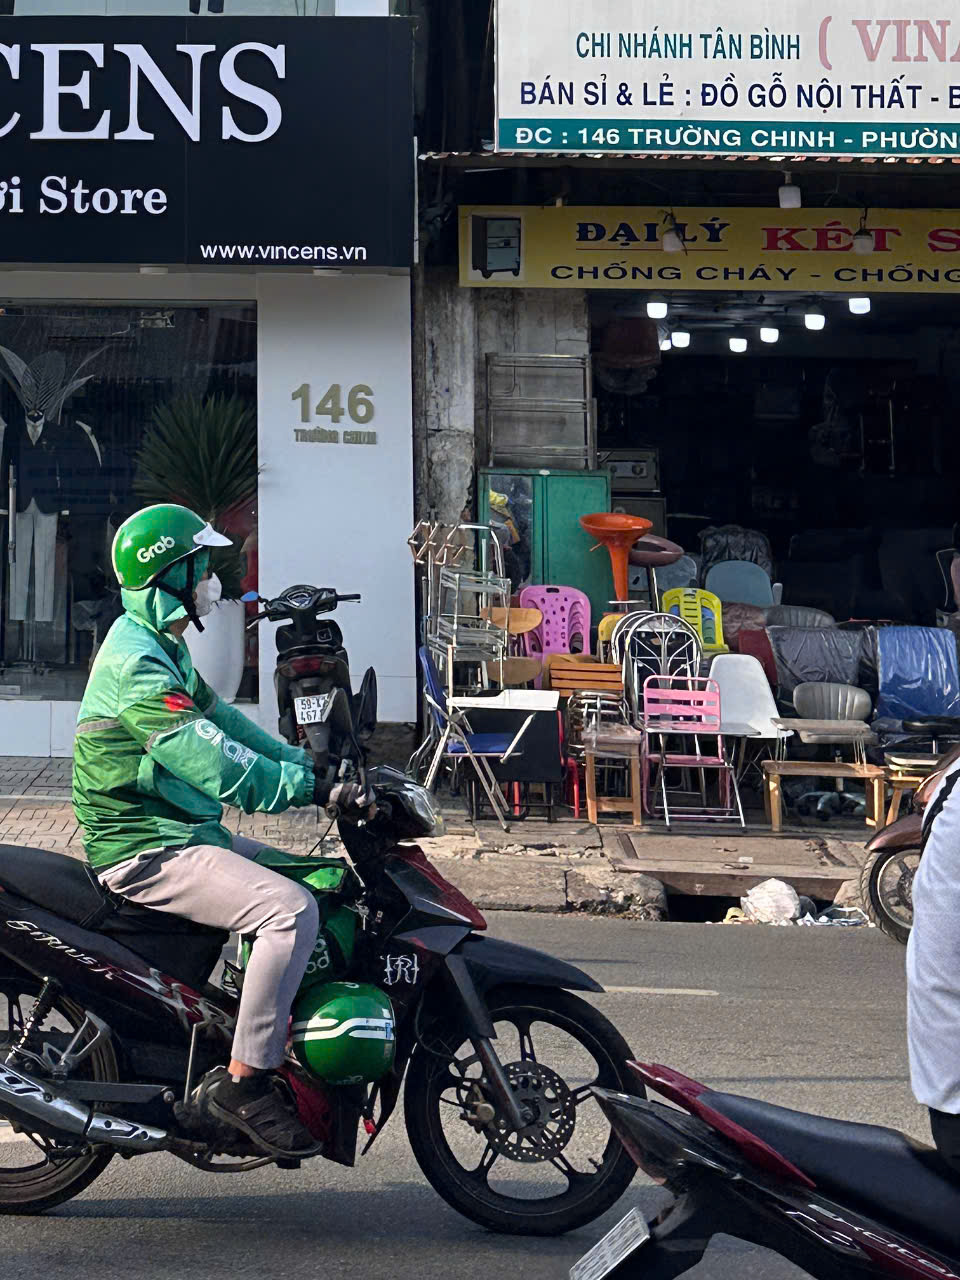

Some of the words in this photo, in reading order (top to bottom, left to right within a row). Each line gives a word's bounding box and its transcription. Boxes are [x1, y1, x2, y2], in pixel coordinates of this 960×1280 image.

[577, 32, 610, 58] CHI
[618, 26, 692, 59] NHÁNH
[700, 27, 742, 59] TÂN
[750, 28, 800, 60] BÌNH
[852, 20, 960, 62] VIN
[521, 75, 573, 105] BÁN
[584, 74, 607, 106] SỈ
[616, 83, 633, 106] &
[643, 73, 674, 106] LẺ
[701, 73, 738, 108] ĐỒ
[748, 72, 787, 108] GỖ
[797, 77, 841, 114] NỘI
[851, 75, 922, 109] THẤT
[515, 127, 552, 145] ĐC
[577, 127, 620, 145] 146
[628, 124, 741, 147] TRƯỜNG
[751, 129, 835, 147] CHINH
[862, 128, 960, 149] PHƯỜN
[40, 176, 168, 214] Store
[576, 222, 660, 247] ĐẠI
[200, 244, 367, 260] www.vincens.vn
[551, 261, 681, 281] CHỐNG
[696, 264, 797, 281] CHÁY
[291, 383, 375, 425] 146
[136, 535, 176, 564] Grab
